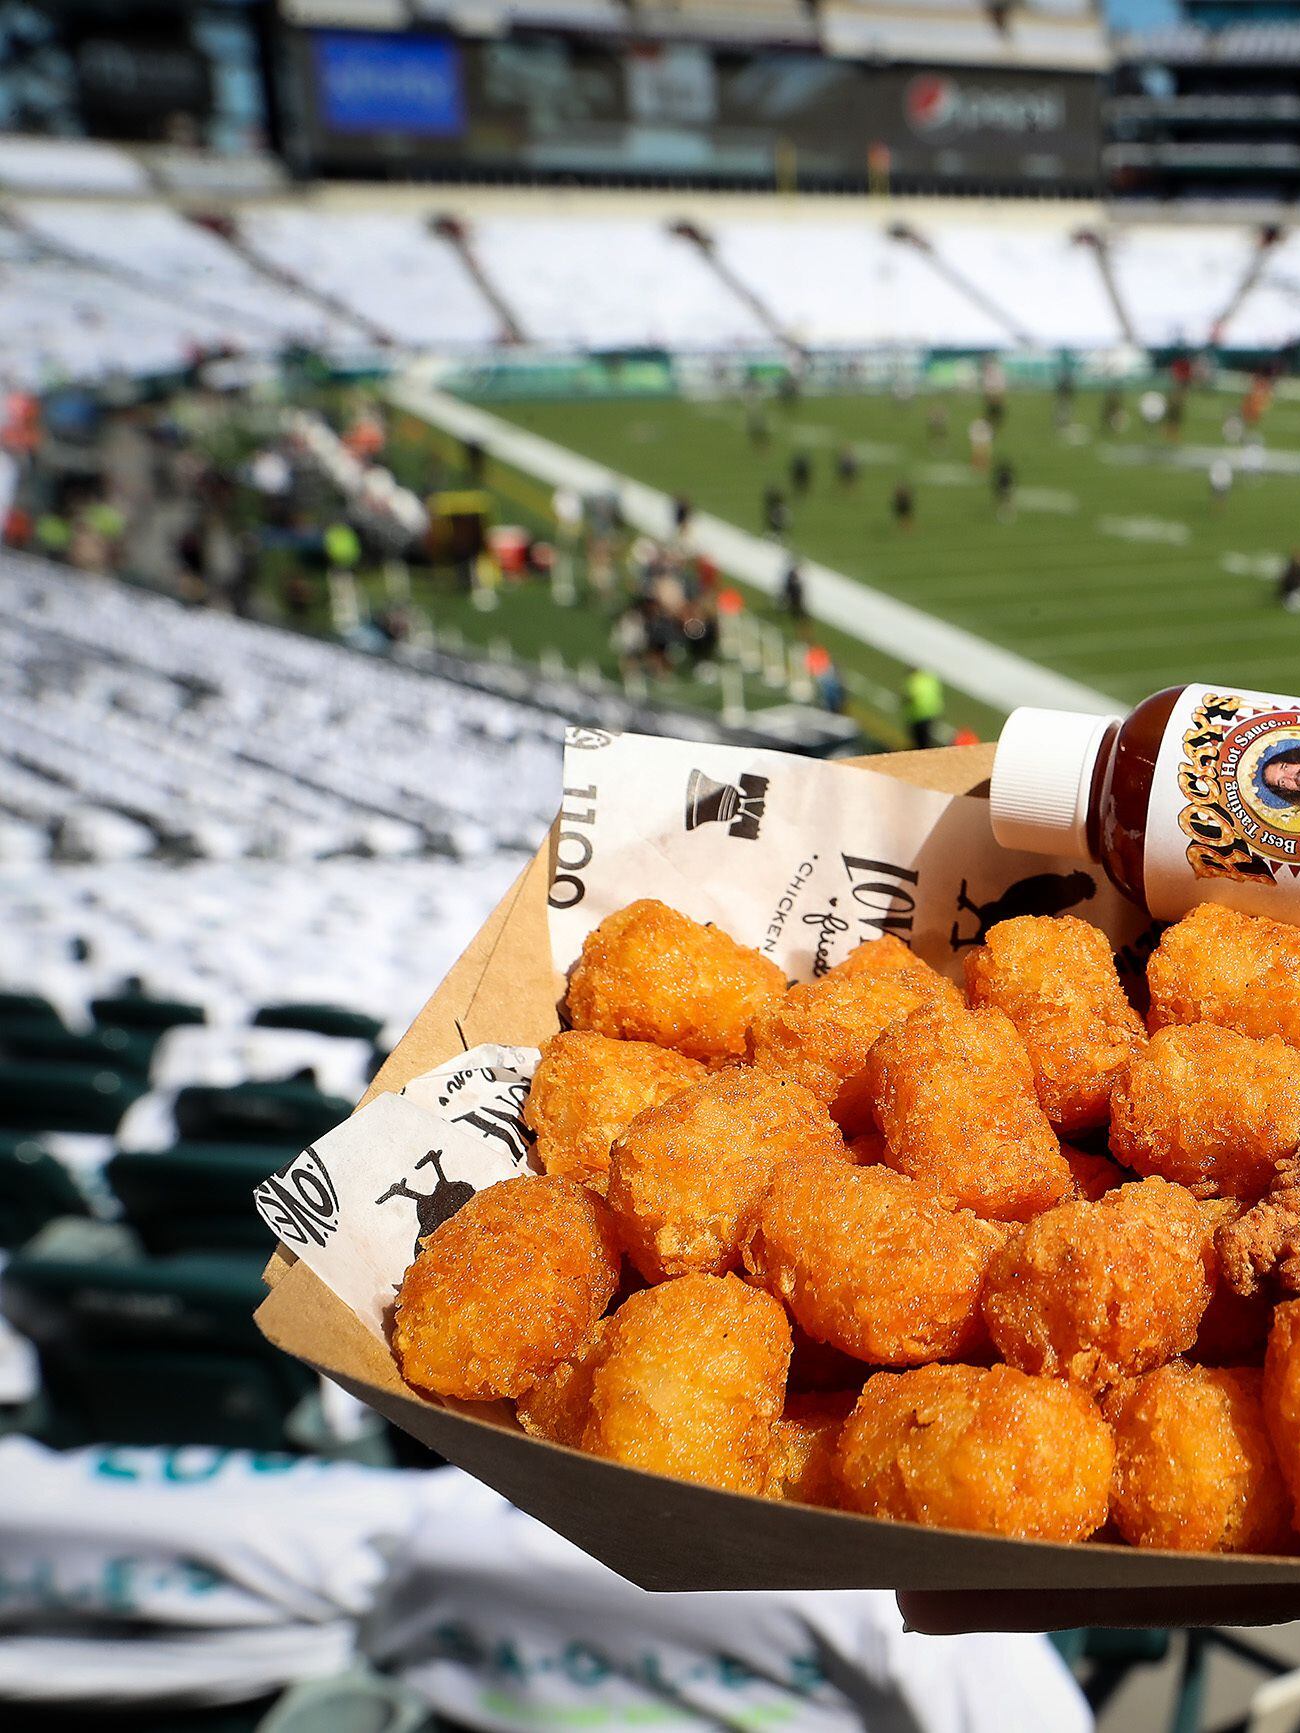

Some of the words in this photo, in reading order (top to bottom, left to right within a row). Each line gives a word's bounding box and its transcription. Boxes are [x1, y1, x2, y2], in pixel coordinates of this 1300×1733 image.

[1221, 747, 1241, 778] Hot
[1225, 781, 1261, 838] Tasting
[1260, 831, 1298, 854] Best
[758, 862, 814, 954] CHICKEN
